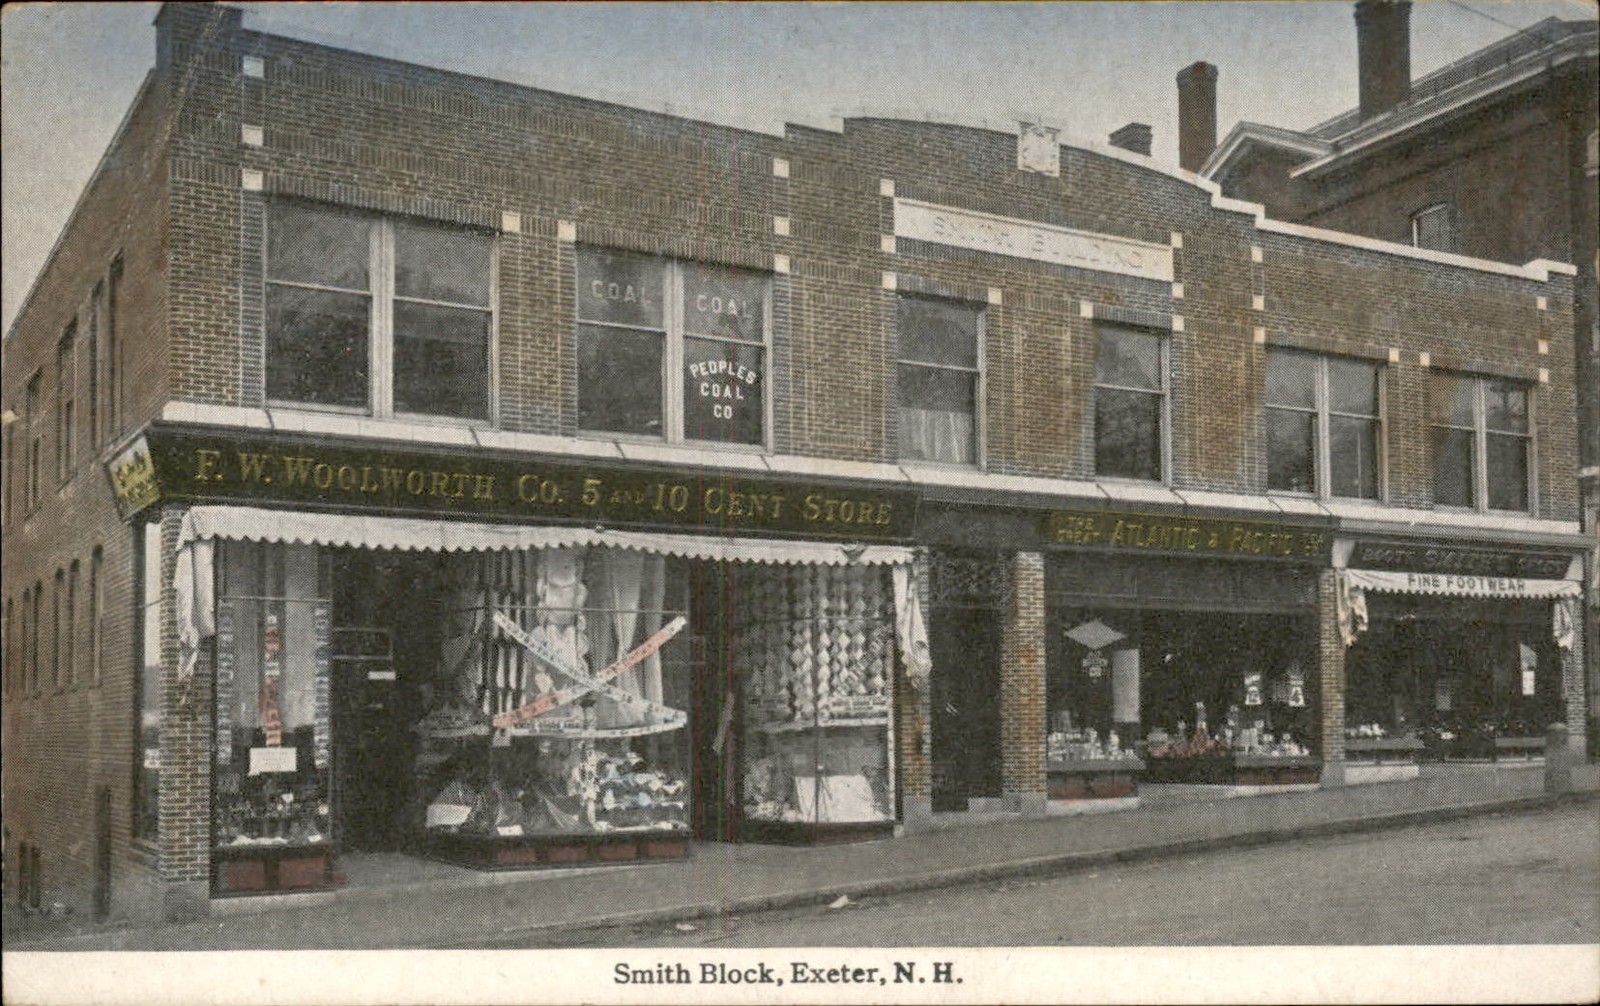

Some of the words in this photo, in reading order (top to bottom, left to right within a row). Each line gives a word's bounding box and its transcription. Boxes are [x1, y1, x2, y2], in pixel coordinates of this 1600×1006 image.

[591, 279, 652, 304] COAL
[696, 293, 753, 318] COAL
[689, 360, 757, 385] PEOPLES
[700, 382, 744, 400] COAL
[713, 404, 733, 419] CO
[195, 449, 223, 482] F.
[239, 452, 272, 485] W.
[283, 456, 496, 500] WOOLWORTH
[581, 479, 601, 506] 5
[652, 483, 689, 513] 10
[704, 487, 786, 519] CENT
[802, 494, 893, 526] STORE
[1111, 520, 1199, 550] ATLANTIC
[1232, 527, 1293, 555] PACIFIC
[1408, 574, 1441, 589] FINE
[1446, 576, 1526, 592] FOOTWEAR
